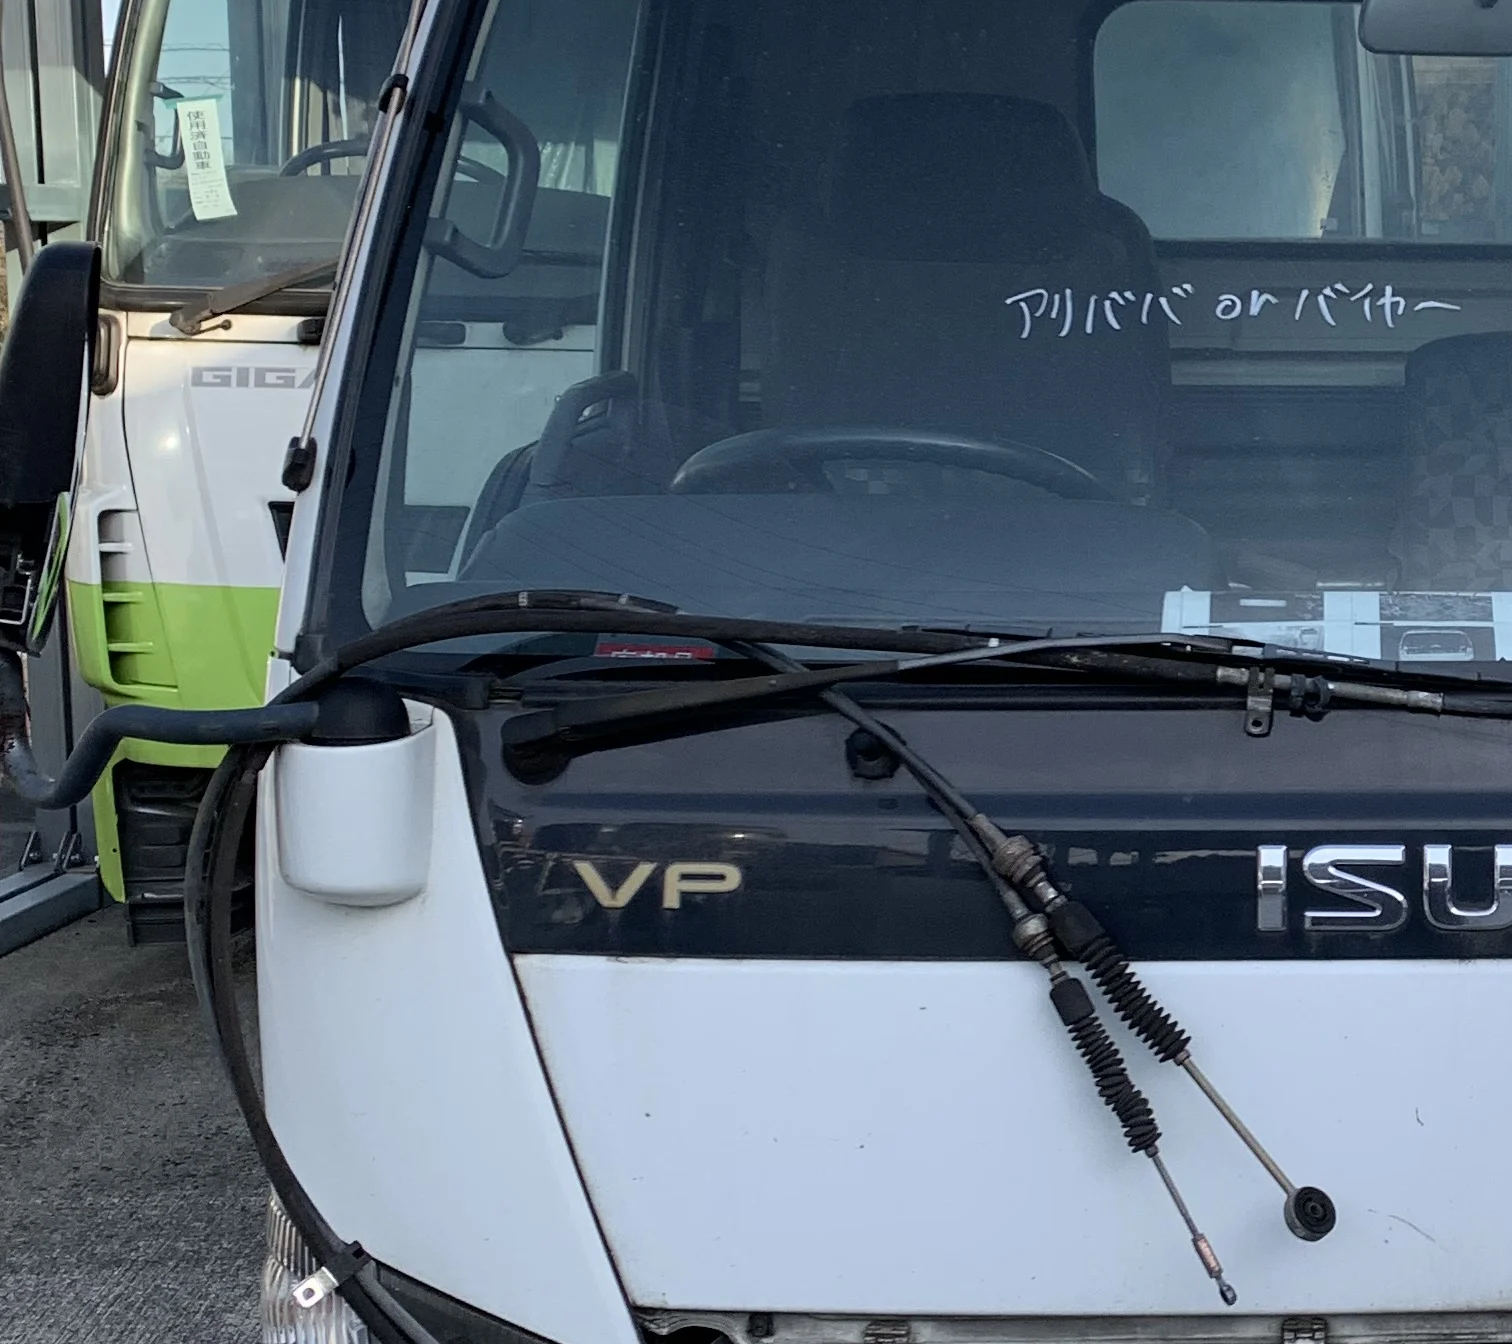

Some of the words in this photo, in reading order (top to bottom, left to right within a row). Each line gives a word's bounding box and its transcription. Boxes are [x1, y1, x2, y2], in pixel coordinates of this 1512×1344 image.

[1004, 283, 1195, 339] アリババ
[1215, 289, 1279, 319] or
[573, 861, 742, 909] VP
